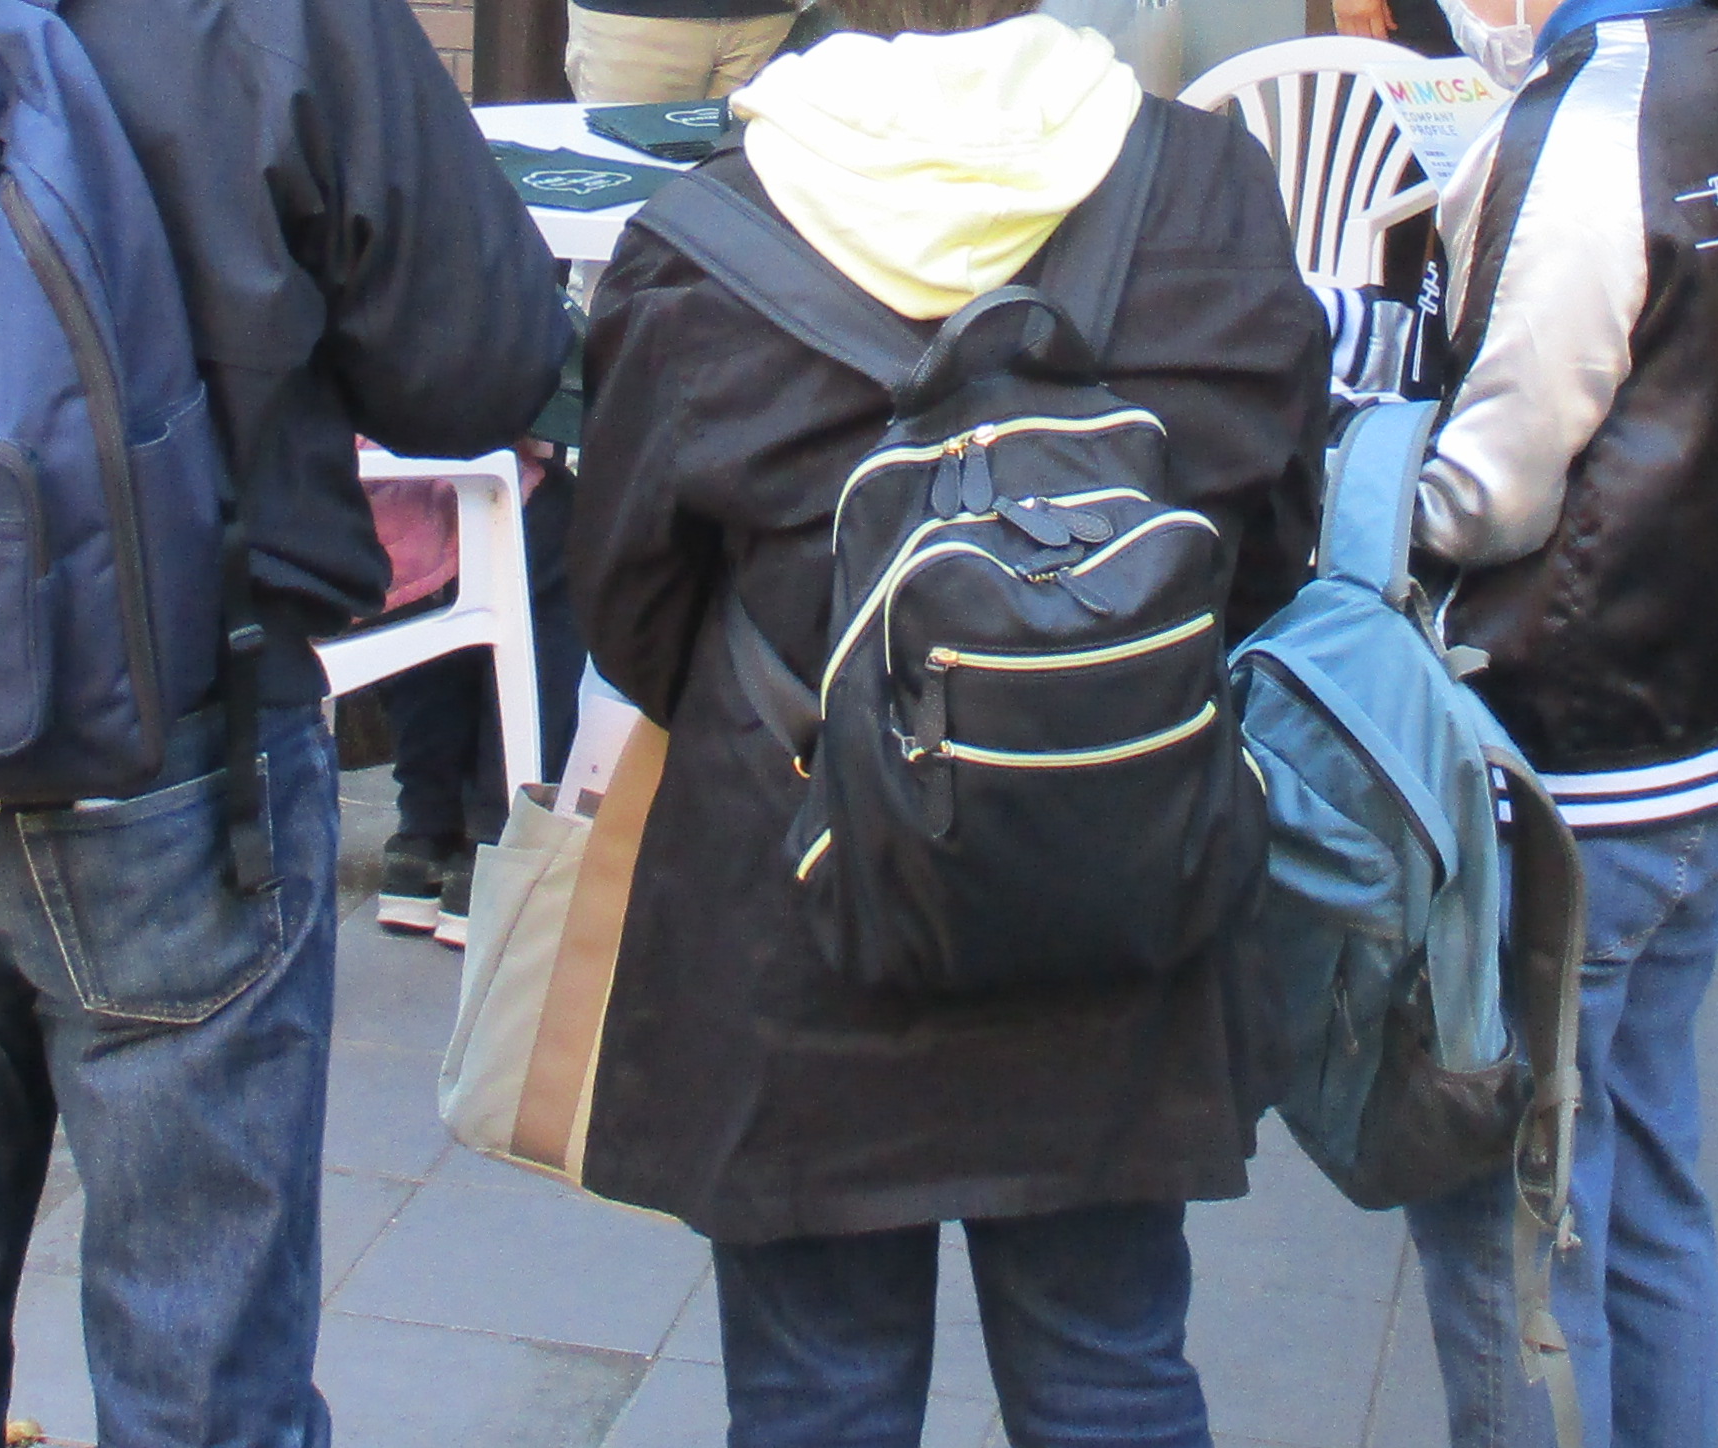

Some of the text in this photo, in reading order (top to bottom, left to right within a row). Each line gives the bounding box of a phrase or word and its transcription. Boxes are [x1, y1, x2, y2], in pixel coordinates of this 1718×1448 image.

[1384, 78, 1495, 105] MIMOSA
[1402, 111, 1457, 124] COMPANY
[1410, 124, 1459, 137] PROFILE
